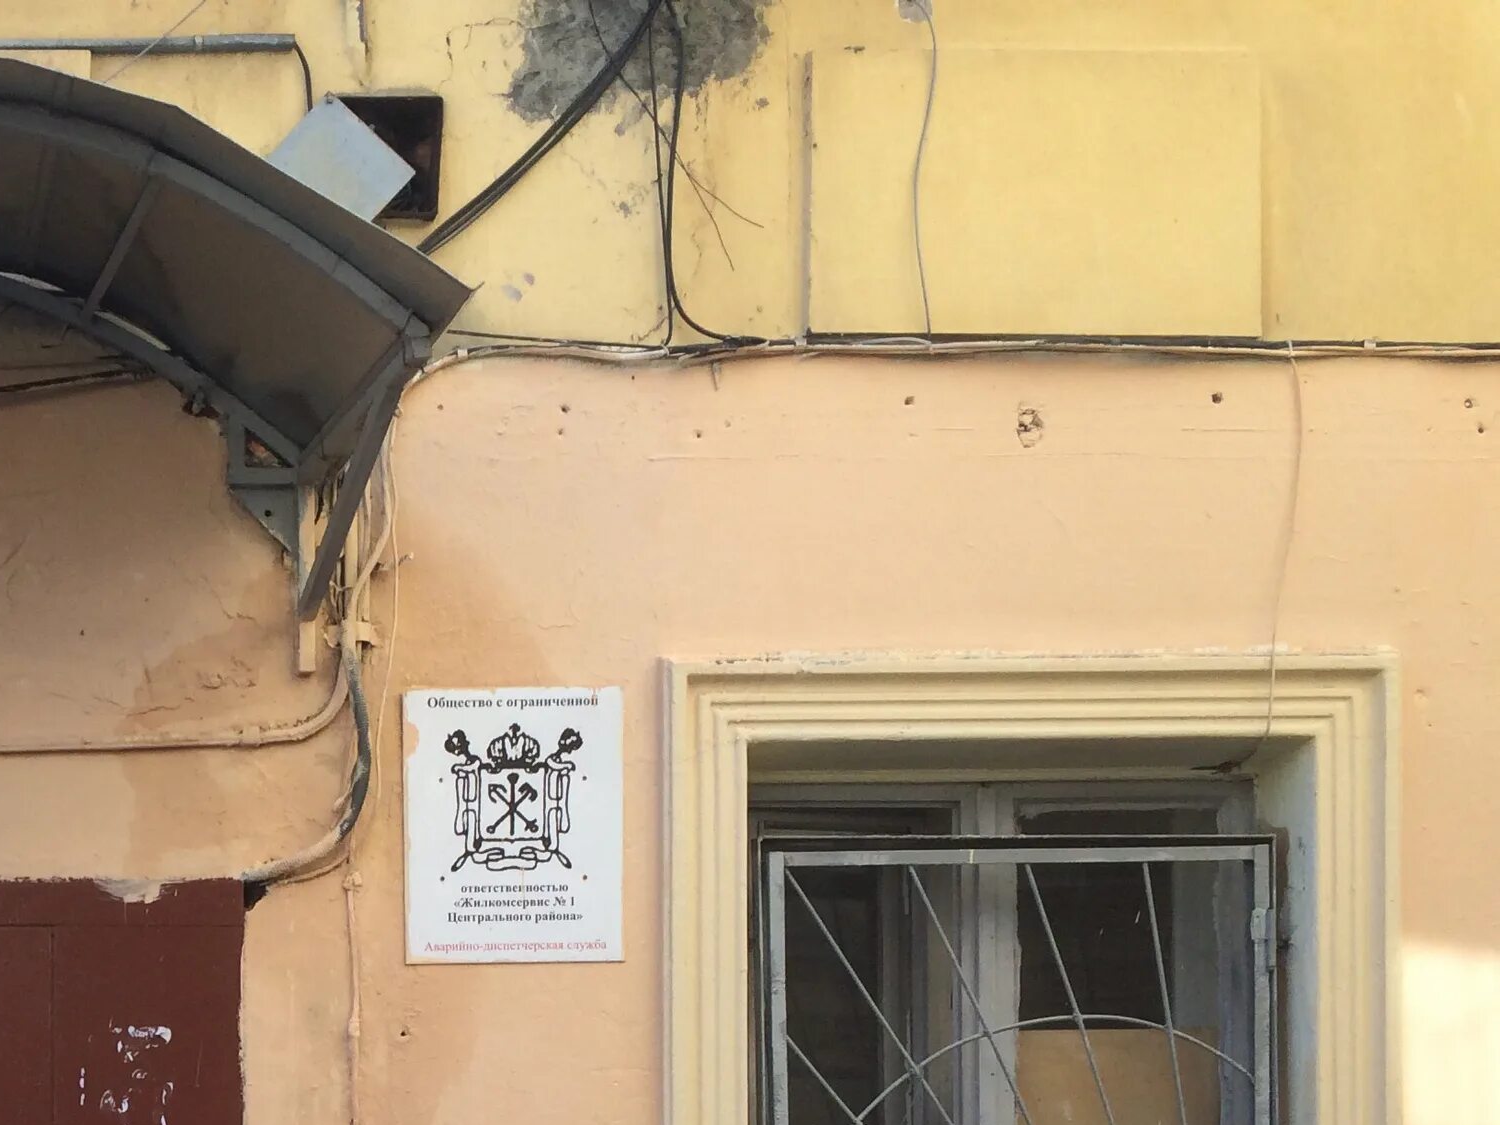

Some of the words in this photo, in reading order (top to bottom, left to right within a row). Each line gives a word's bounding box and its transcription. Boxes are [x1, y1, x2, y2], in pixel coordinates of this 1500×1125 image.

[427, 696, 493, 709] Общество
[496, 699, 504, 708] с
[506, 694, 599, 710] ограниченной
[454, 897, 550, 910] «Жилкомсервис
[553, 896, 567, 907] №
[570, 896, 576, 907] 1
[447, 912, 532, 924] Центрального
[535, 911, 584, 923] района»
[424, 941, 564, 954] Аварийно-диспетчерская
[567, 939, 608, 953] служба
